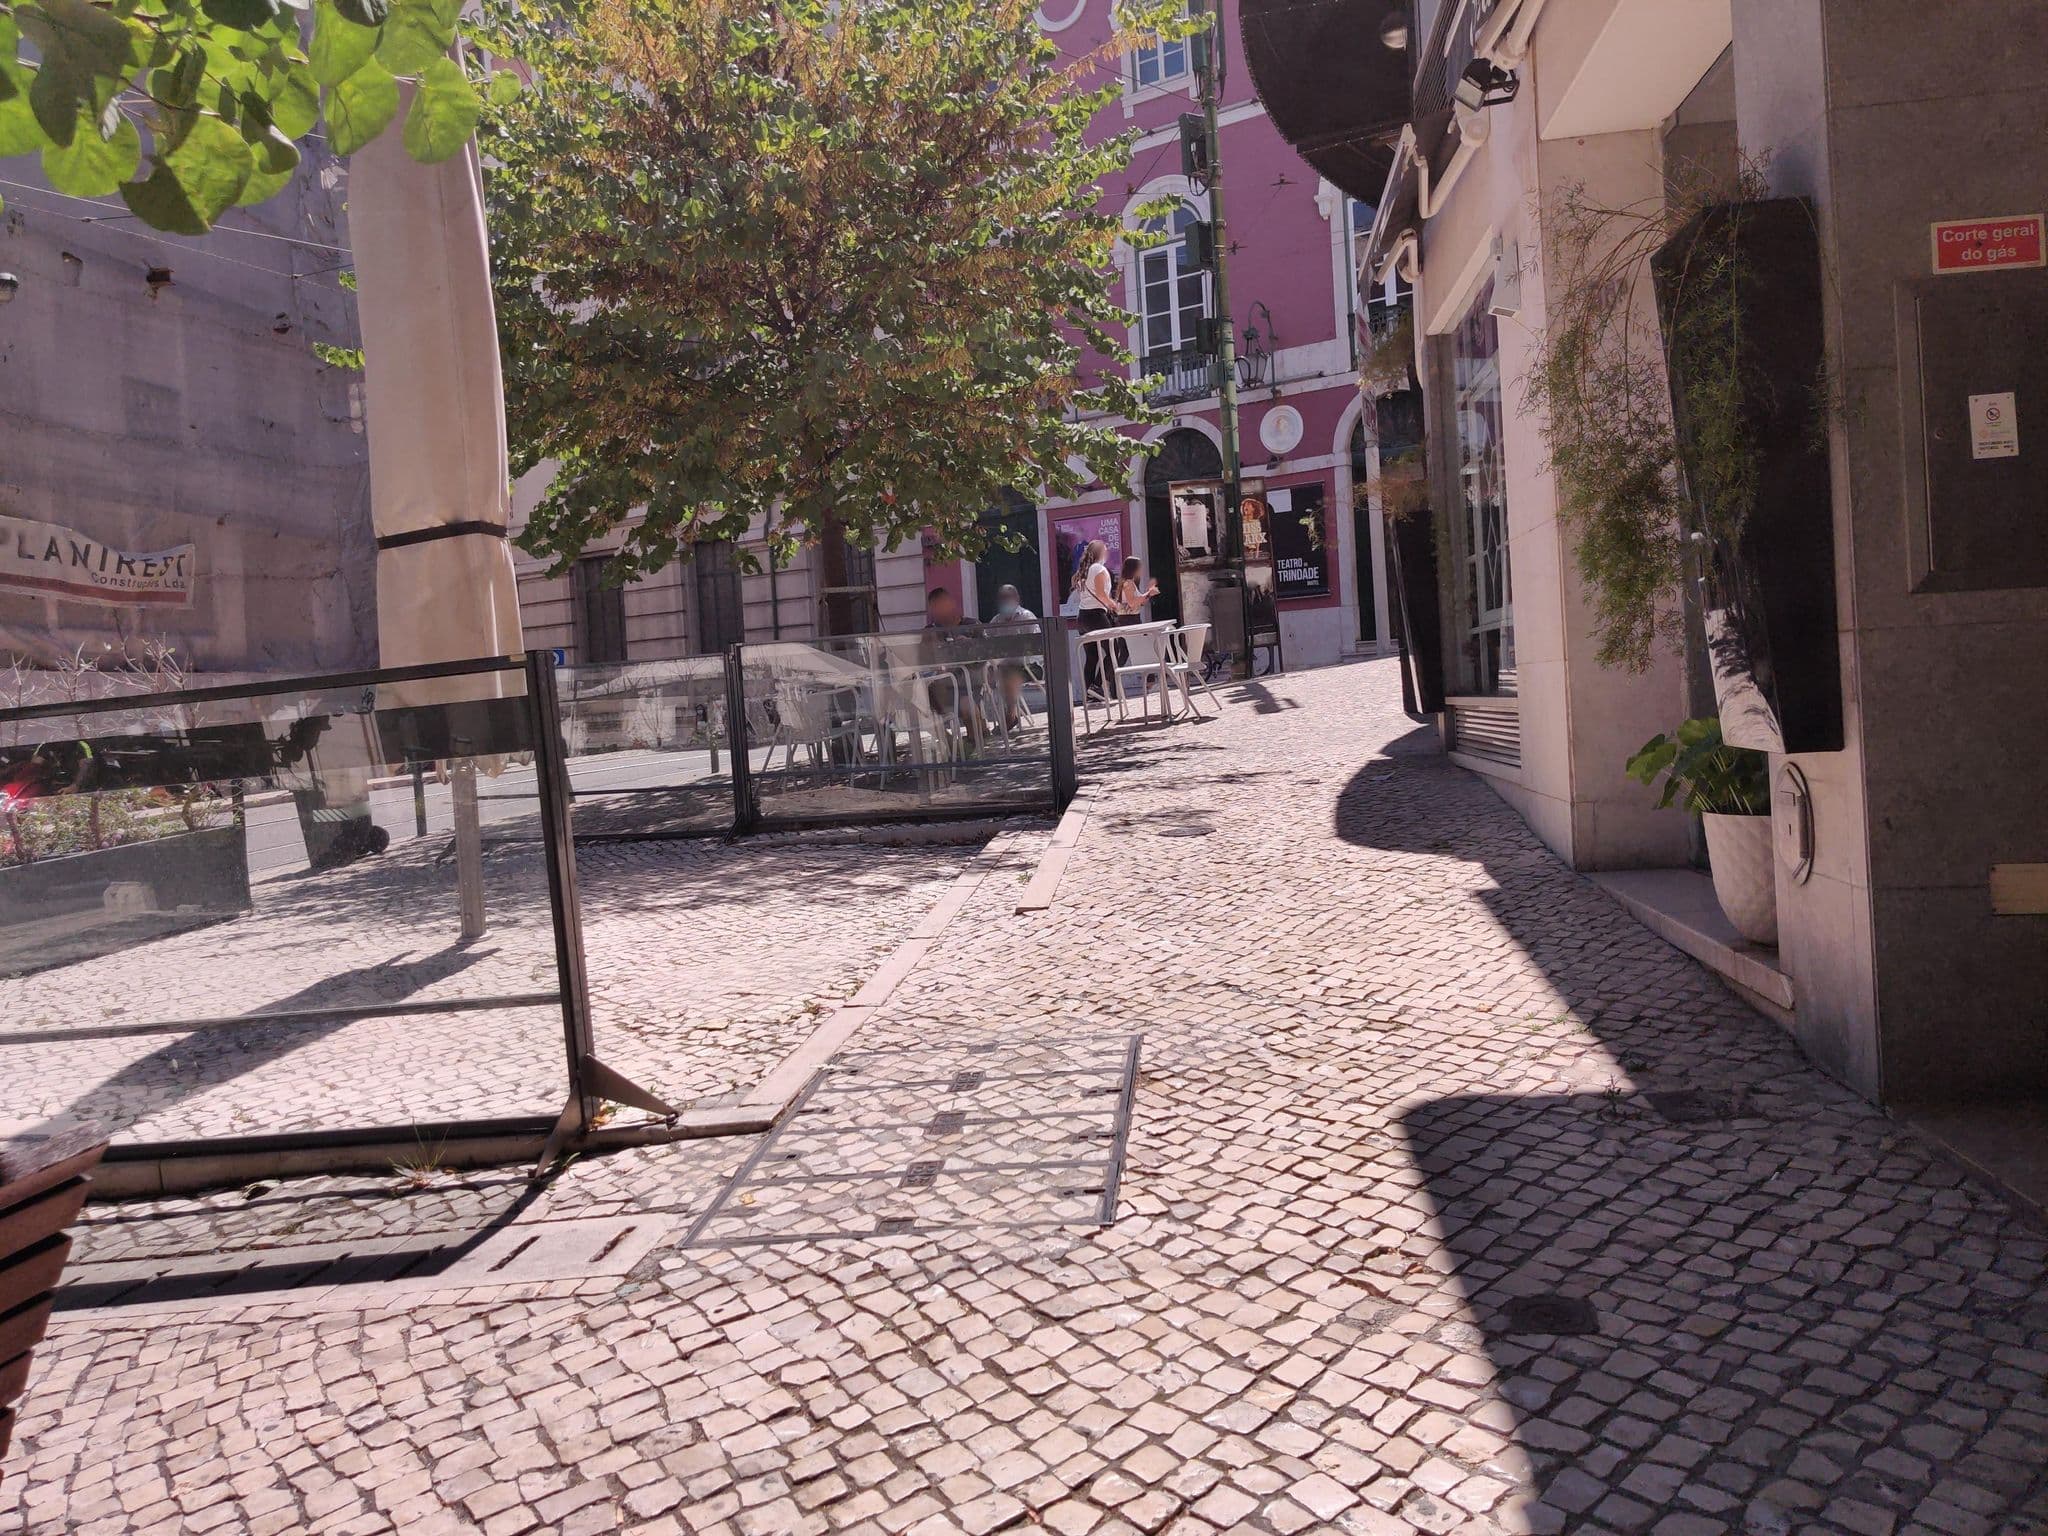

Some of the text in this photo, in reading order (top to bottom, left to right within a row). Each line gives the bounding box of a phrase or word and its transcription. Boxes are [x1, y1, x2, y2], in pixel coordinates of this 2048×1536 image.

[1942, 224, 2034, 243] Corte geral
[1961, 244, 2017, 261] do gás
[1100, 518, 1119, 527] UMA
[1108, 534, 1120, 542] DE
[1277, 558, 1303, 570] TEATRO
[1277, 566, 1320, 582] TRINDADE
